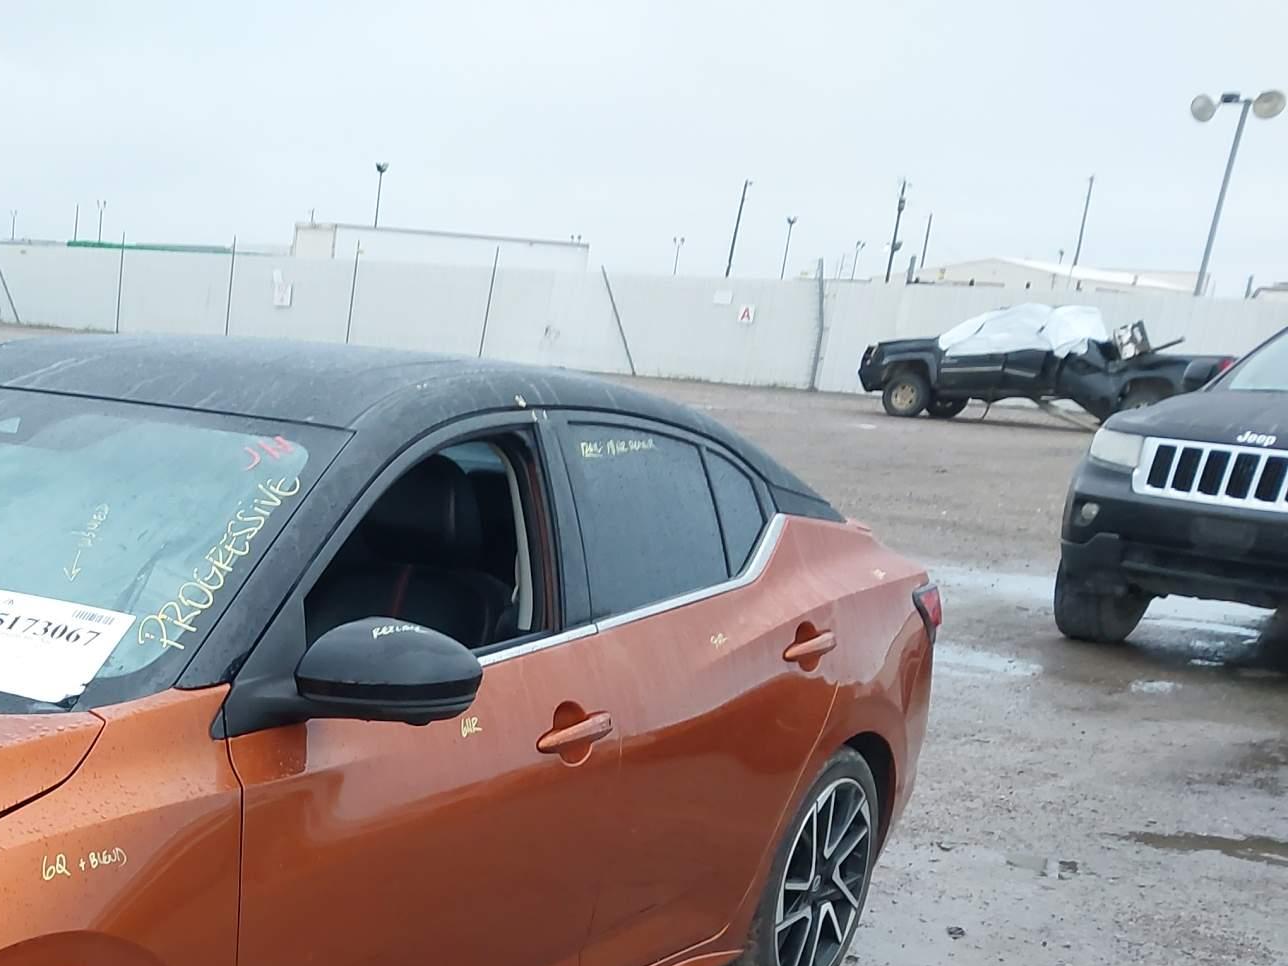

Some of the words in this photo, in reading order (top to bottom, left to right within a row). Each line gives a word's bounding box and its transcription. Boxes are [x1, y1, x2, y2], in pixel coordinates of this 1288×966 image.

[740, 306, 751, 321] A
[1236, 430, 1277, 447] Jeep
[138, 475, 300, 650] PROGRESSIVE
